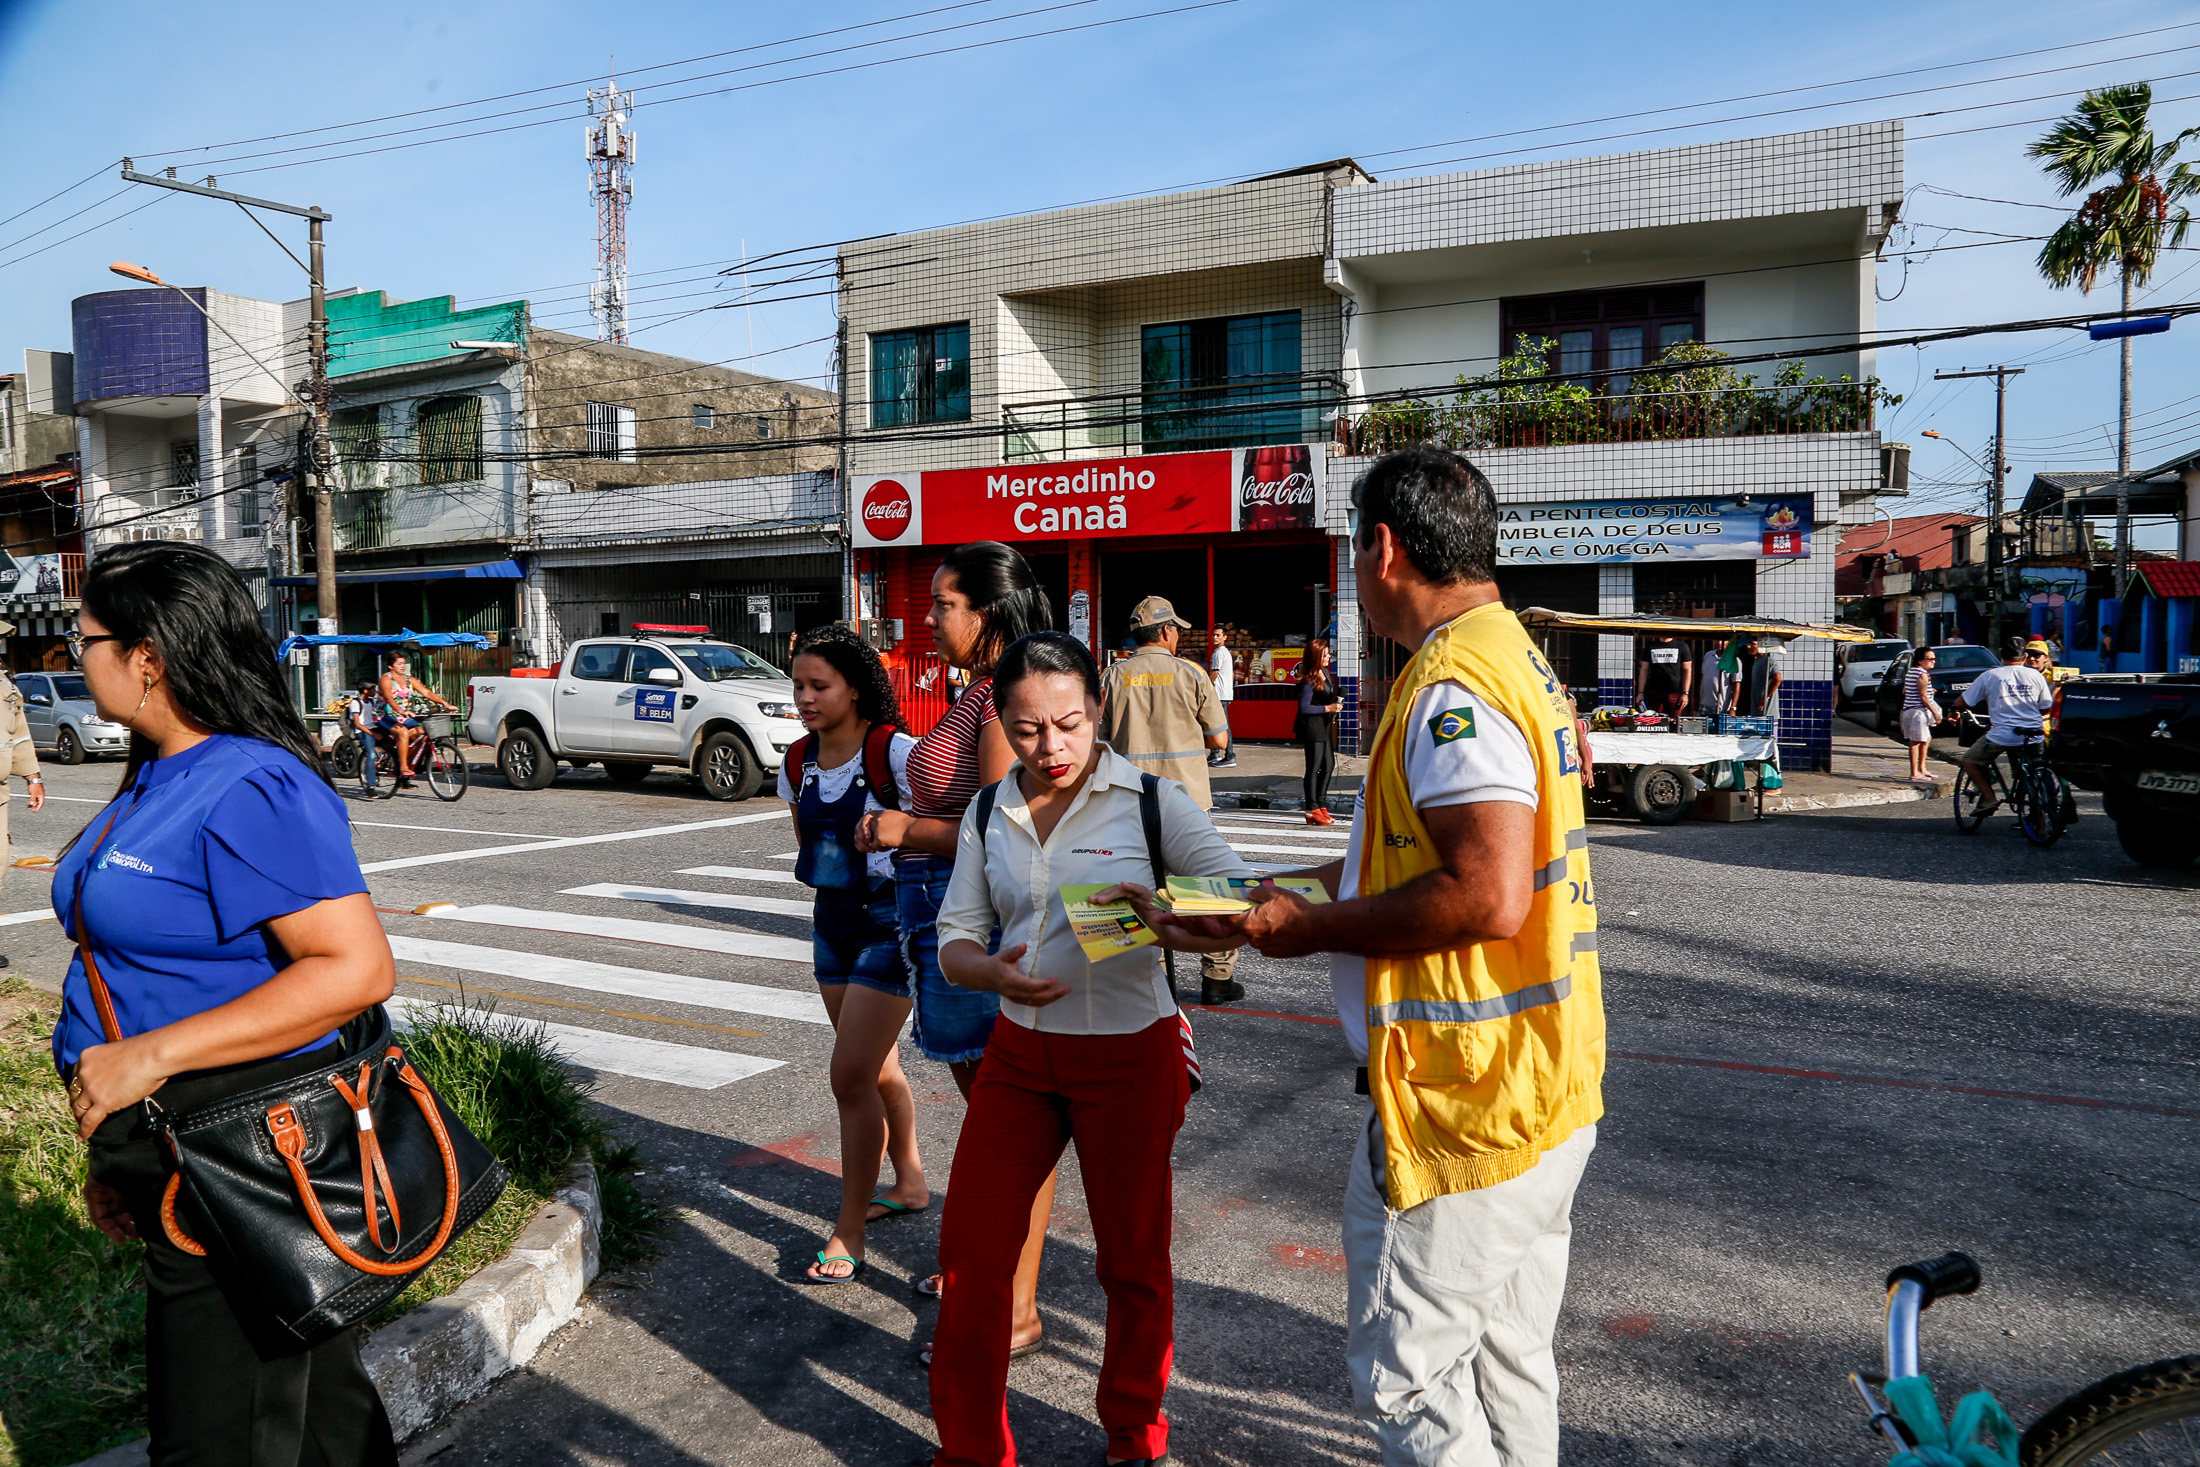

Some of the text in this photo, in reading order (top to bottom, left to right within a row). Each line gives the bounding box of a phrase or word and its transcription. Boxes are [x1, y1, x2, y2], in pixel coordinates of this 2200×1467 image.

[987, 465, 1156, 498] Mercadinho
[1240, 472, 1313, 507] Coca-Cola
[865, 500, 910, 520] Coca-Cola
[1014, 495, 1127, 533] Canaã
[1530, 503, 1720, 521] PENTECOSTAL
[1604, 524, 1638, 538] DE
[1647, 522, 1722, 536] DEUS
[1550, 545, 1565, 557] E
[1573, 542, 1670, 557] ÔMEGA
[650, 709, 672, 719] BELÉM
[1091, 926, 1119, 935] amigo
